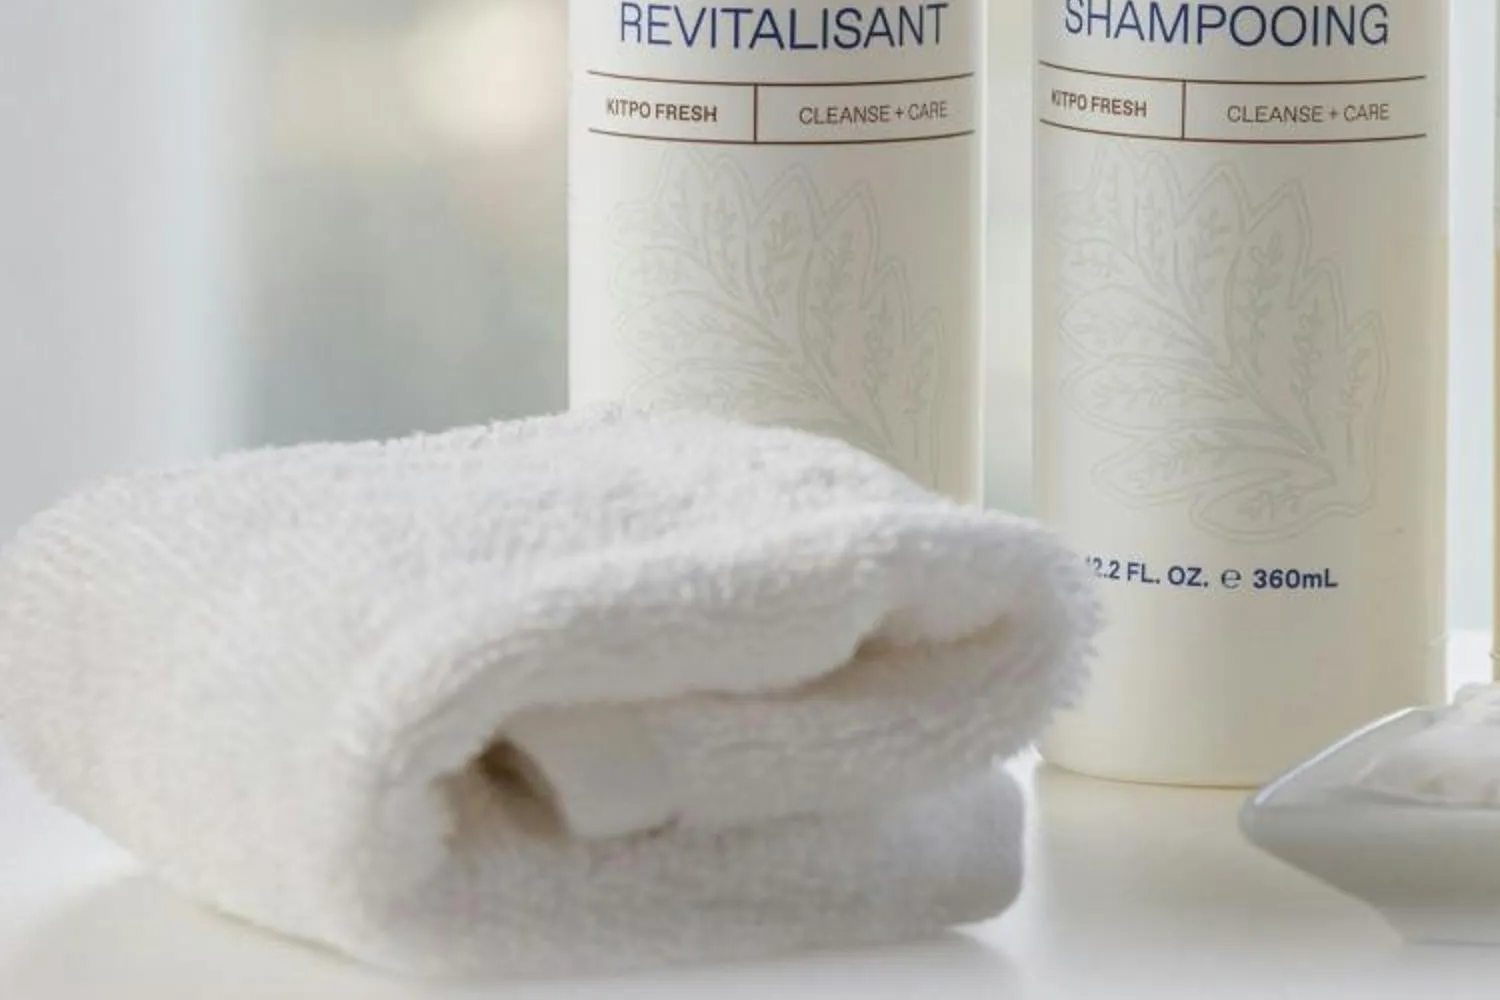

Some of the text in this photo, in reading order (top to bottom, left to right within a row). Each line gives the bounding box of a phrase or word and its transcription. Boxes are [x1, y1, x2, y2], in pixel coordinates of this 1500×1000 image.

[621, 2, 948, 50] REVITALISANT
[607, 99, 717, 122] KITPO FRESH
[799, 105, 890, 125] CLEANSE
[908, 100, 947, 120] CARE
[1091, 96, 1146, 117] FRESH
[1227, 105, 1323, 123] CLEANSE
[1344, 104, 1389, 122] CARE
[1127, 562, 1160, 584] FL.
[1168, 566, 1208, 587] OZ.
[1253, 568, 1338, 589] 360mL
